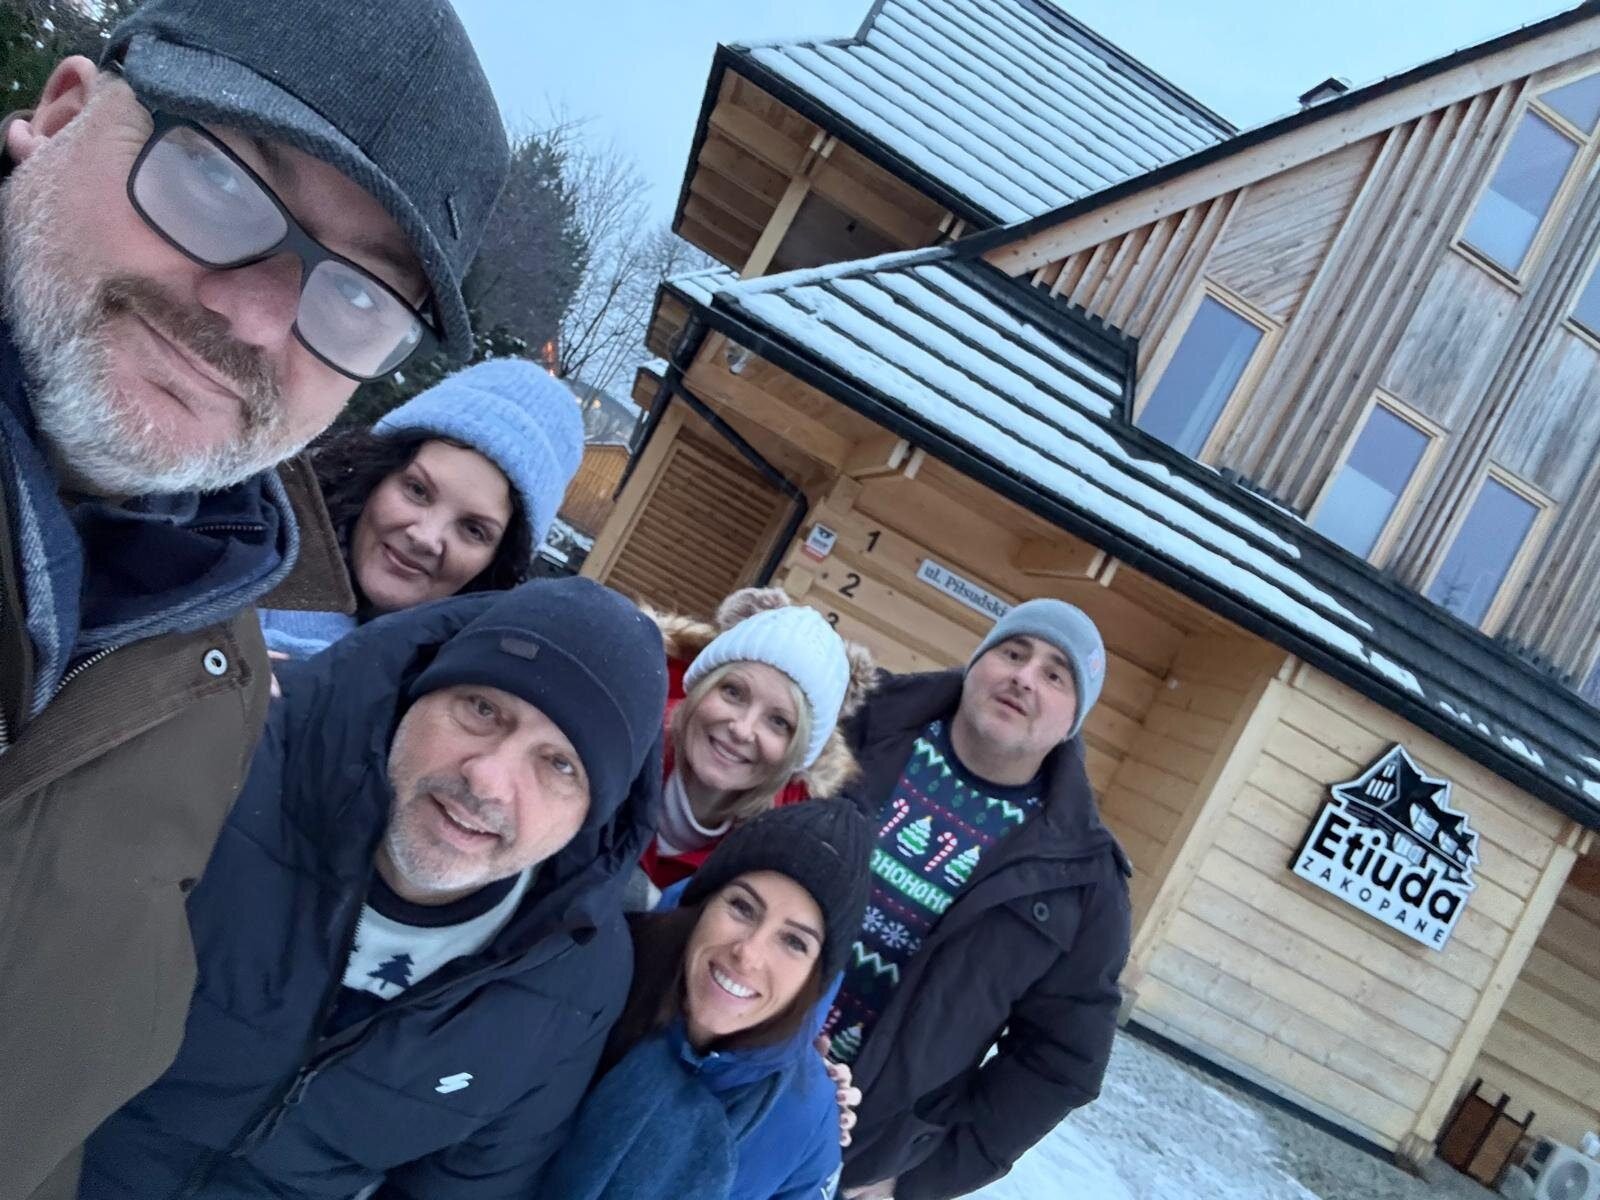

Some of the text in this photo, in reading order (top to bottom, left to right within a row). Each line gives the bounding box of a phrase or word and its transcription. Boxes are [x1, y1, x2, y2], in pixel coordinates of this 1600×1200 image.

[867, 530, 881, 552] 1
[839, 572, 861, 598] 2
[924, 566, 942, 583] ul.
[1312, 810, 1462, 925] Etiuda
[1302, 856, 1445, 943] ZAKOPANE
